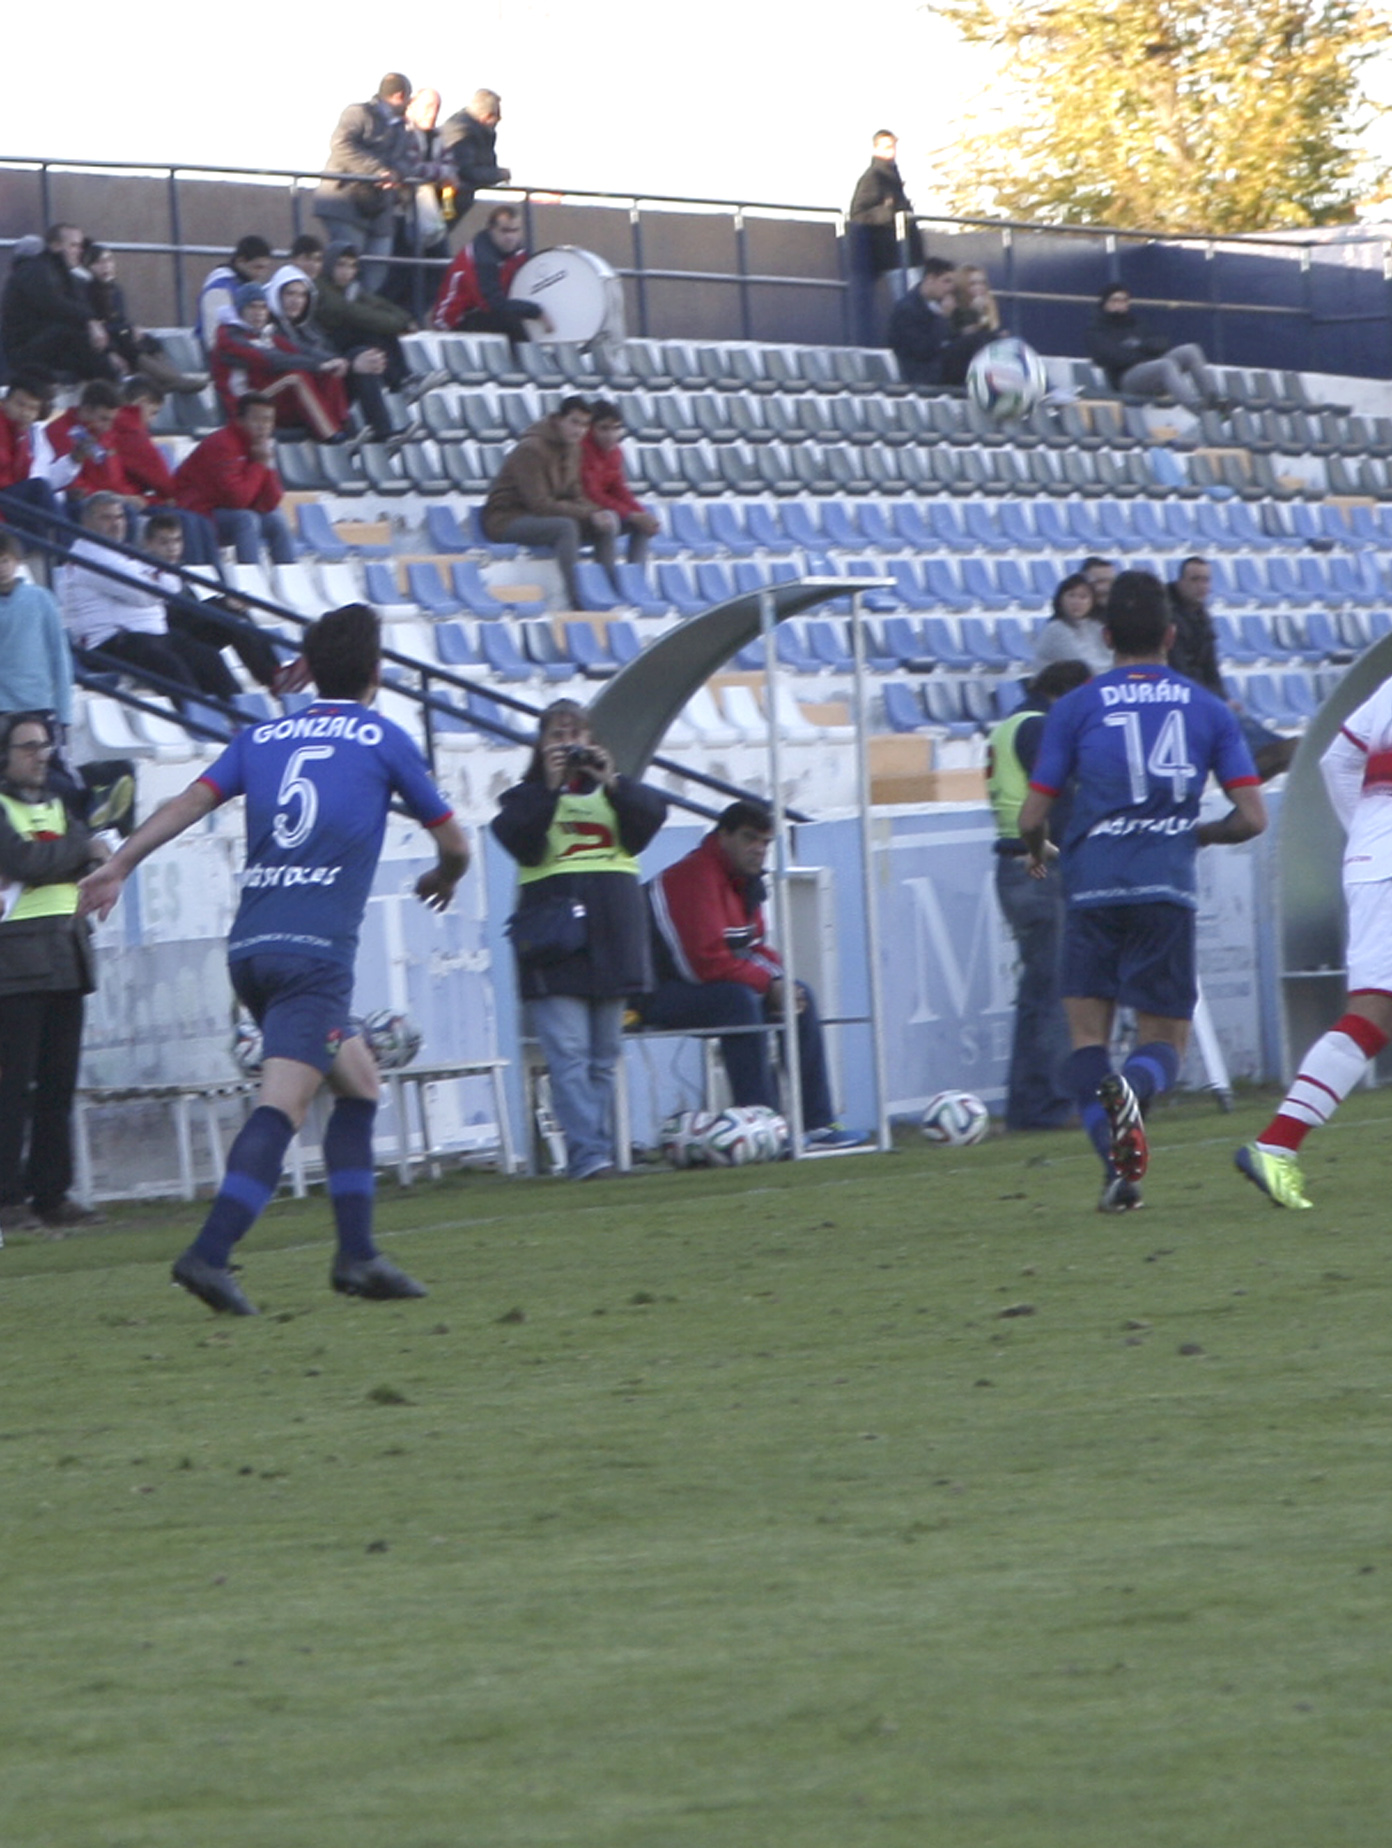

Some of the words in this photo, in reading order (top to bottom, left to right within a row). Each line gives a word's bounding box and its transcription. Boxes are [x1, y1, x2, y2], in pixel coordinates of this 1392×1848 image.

[1101, 679, 1192, 706] DURÁN
[252, 716, 384, 746] GONZALO
[1102, 709, 1198, 805] 14
[272, 745, 335, 849] 5
